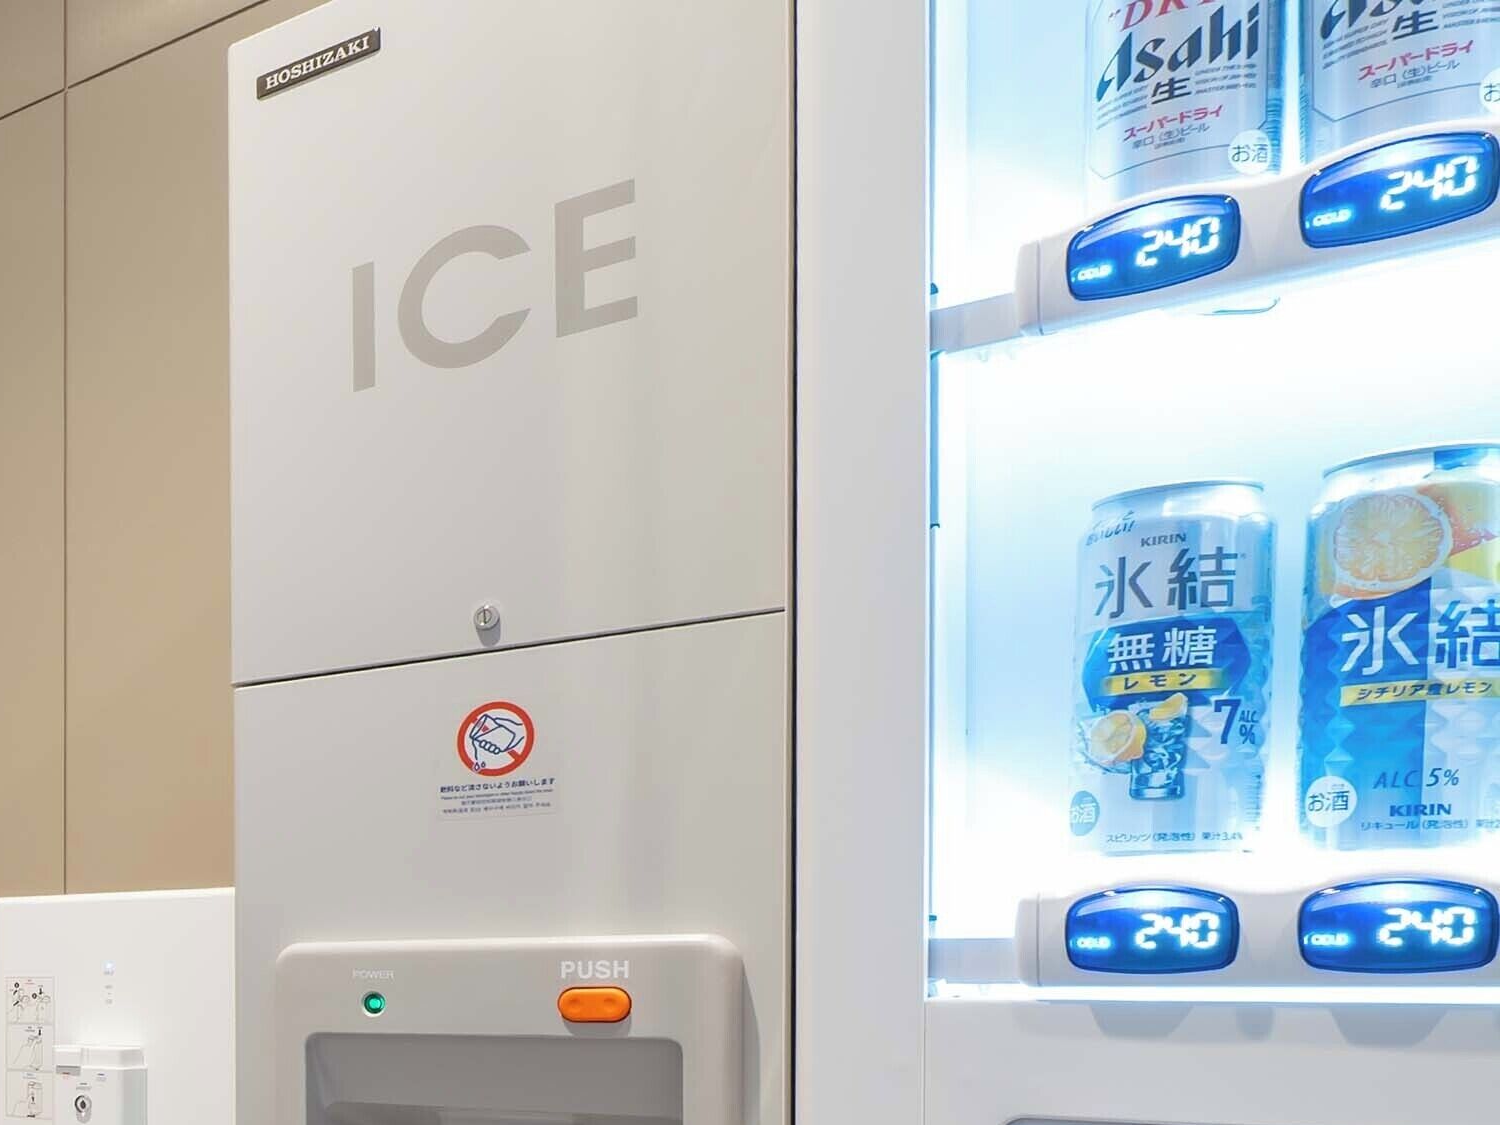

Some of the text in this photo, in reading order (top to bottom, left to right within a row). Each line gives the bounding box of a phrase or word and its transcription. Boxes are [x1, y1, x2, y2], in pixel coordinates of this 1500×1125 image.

[1392, 10, 1439, 40] 生
[265, 36, 370, 90] HOSHIZAKI
[1096, 3, 1260, 102] Asahi
[1358, 40, 1474, 80] スーパードライ
[1151, 77, 1192, 105] 生
[1124, 104, 1223, 141] スーパードライ
[1231, 144, 1268, 164] お酒
[1380, 157, 1479, 210] 240
[1136, 217, 1220, 268] 240
[352, 178, 638, 392] ICE
[1140, 533, 1187, 547] KIRIN
[1095, 546, 1238, 619] 氷結
[1107, 625, 1218, 673] 無糖
[1340, 599, 1500, 676] 氷結
[1124, 672, 1197, 690] レモン
[1357, 682, 1492, 700] シチリア産レモン
[1214, 699, 1242, 745] 7
[1239, 710, 1259, 723] ALC
[1240, 729, 1256, 745] %
[1373, 767, 1460, 789] ALC 5%
[1307, 790, 1350, 812] お酒
[1389, 803, 1452, 817] KIRIN
[1136, 912, 1219, 948] 240
[1379, 907, 1476, 946] 240
[352, 968, 394, 980] POWER
[560, 960, 630, 979] PUSH
